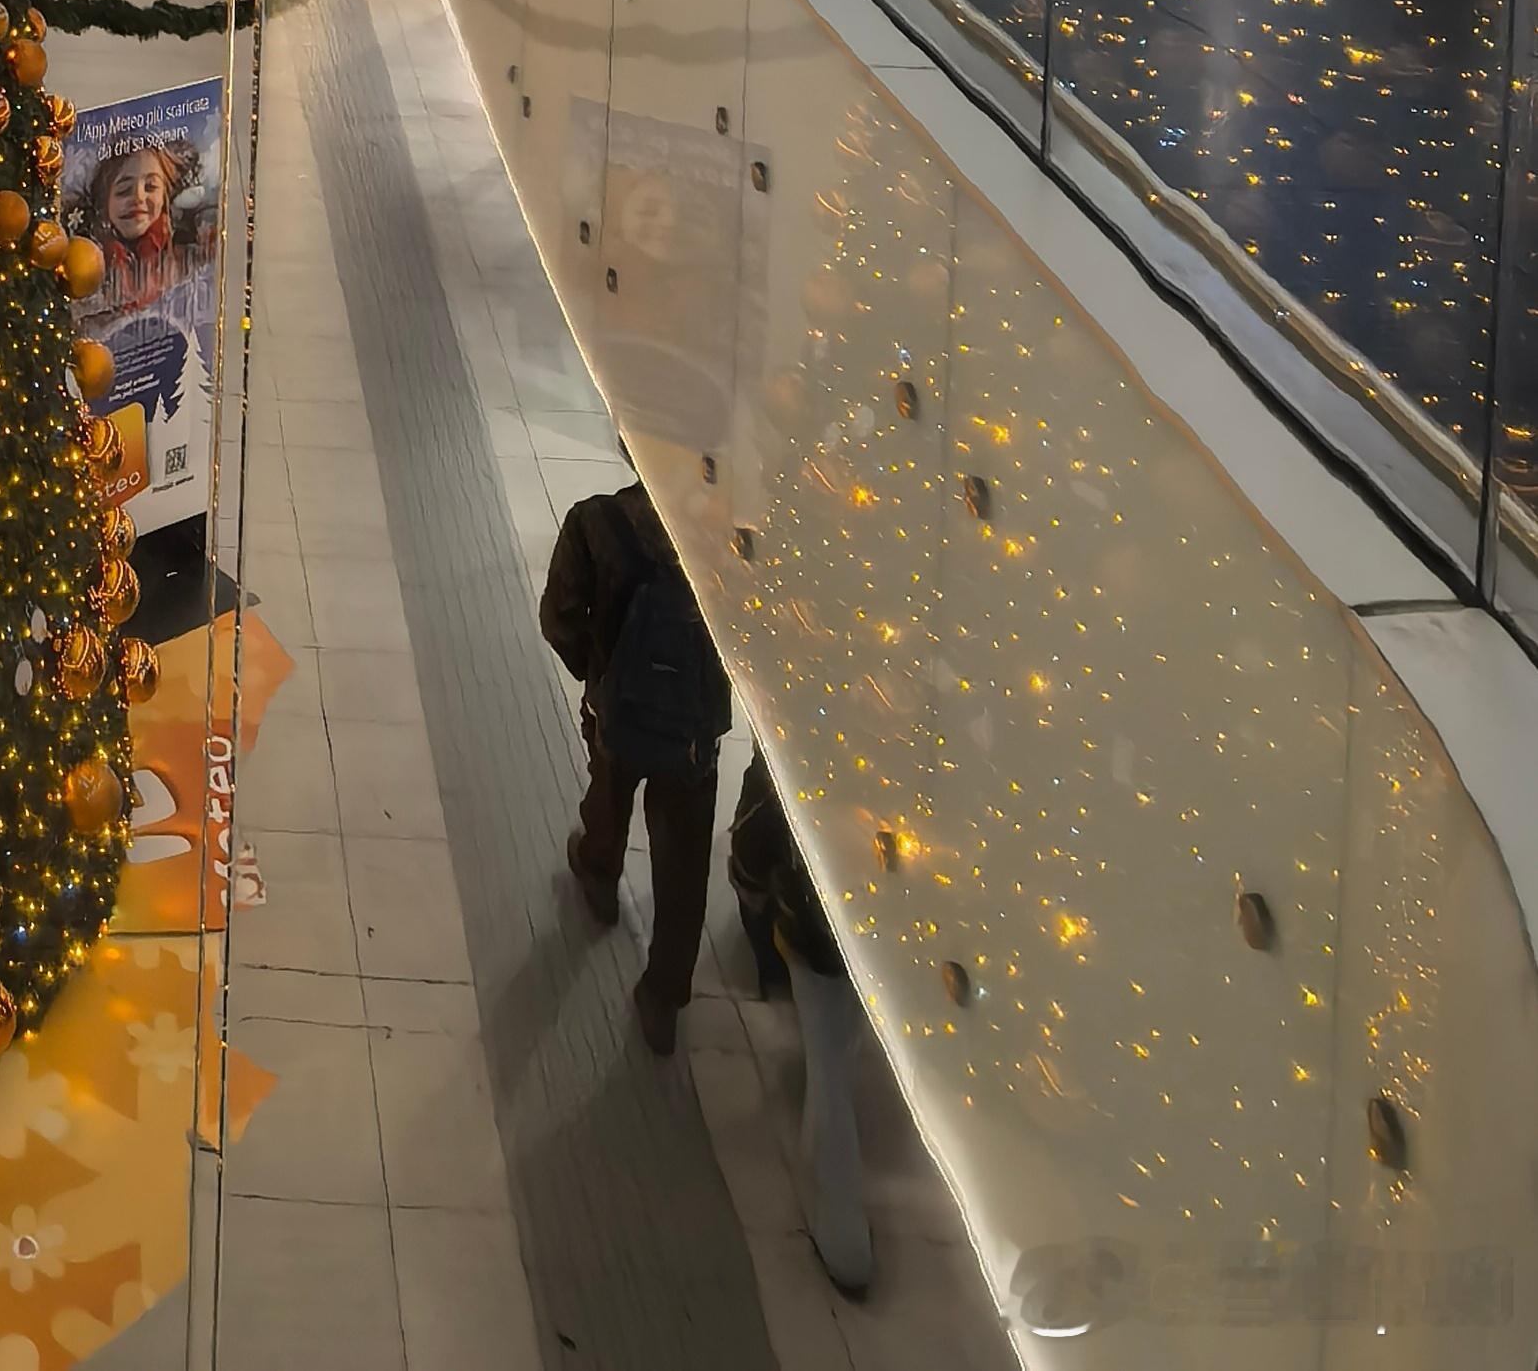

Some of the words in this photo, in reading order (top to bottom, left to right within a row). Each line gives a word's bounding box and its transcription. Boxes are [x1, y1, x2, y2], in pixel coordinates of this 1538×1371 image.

[76, 121, 106, 143] L'App
[109, 113, 144, 135] Meteo
[146, 105, 164, 129] più
[165, 96, 210, 121] scaricata
[97, 141, 112, 162] da
[114, 136, 131, 157] chi
[132, 135, 144, 151] sa
